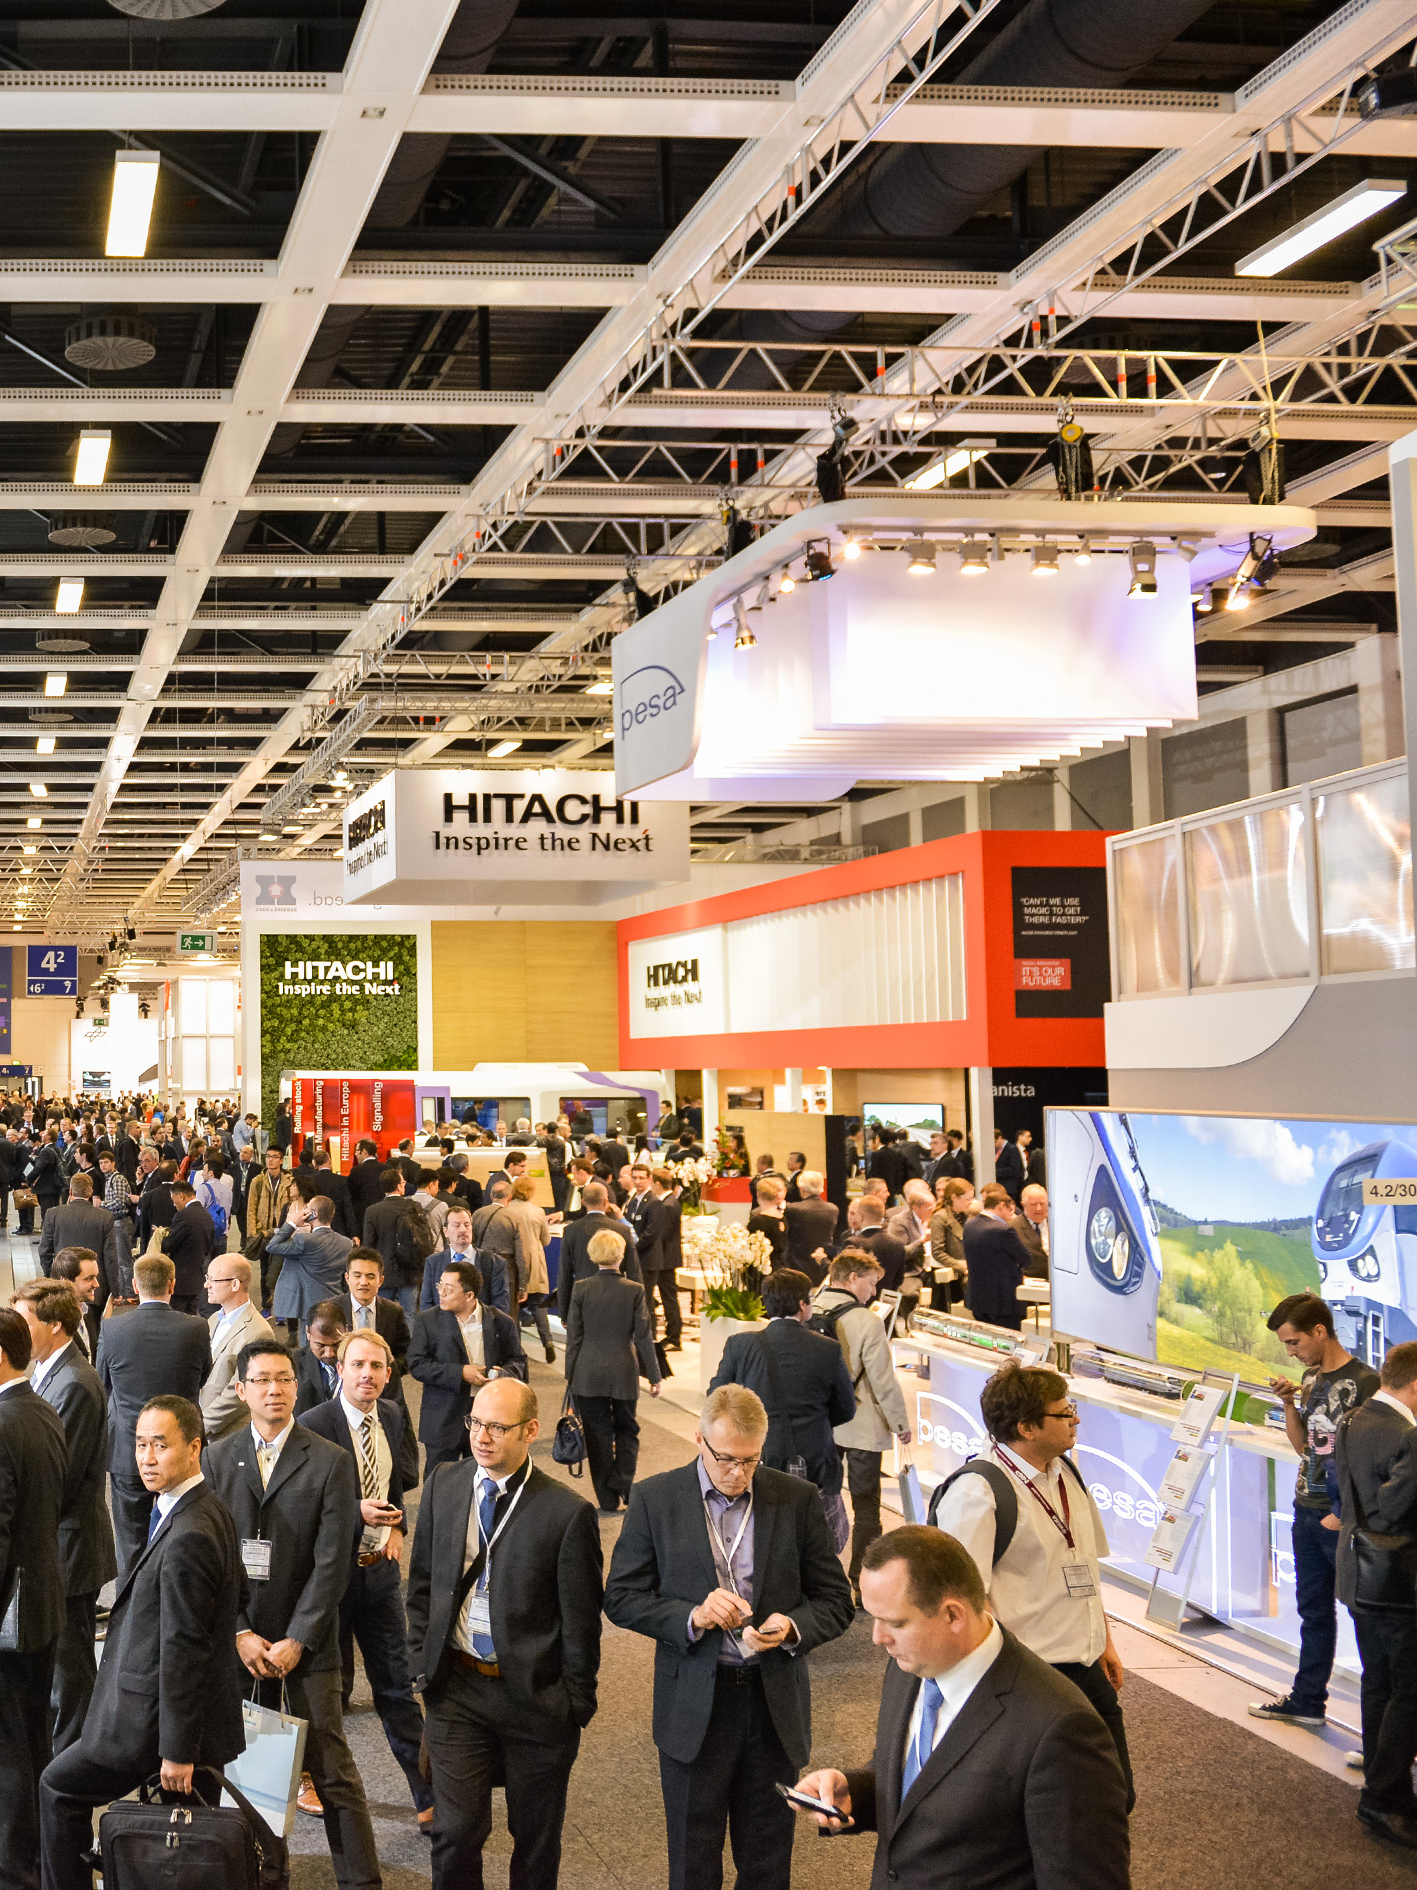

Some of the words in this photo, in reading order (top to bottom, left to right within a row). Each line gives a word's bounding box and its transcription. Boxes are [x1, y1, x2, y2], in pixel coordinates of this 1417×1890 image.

[621, 685, 677, 741] pesa
[443, 792, 640, 825] HITACHI
[432, 830, 528, 855] Inspire
[538, 831, 581, 851] the
[589, 828, 654, 852] Next
[1024, 906, 1050, 915] MAGIC
[1052, 906, 1063, 915] TO
[1065, 906, 1081, 915] GET
[1049, 897, 1062, 906] WE
[1064, 897, 1080, 906] USE
[1024, 915, 1050, 924] THERE
[285, 961, 394, 980] HITACHI
[646, 958, 699, 988] HITACHI
[1022, 967, 1040, 976] IT'S
[1042, 967, 1064, 976] OUR
[278, 982, 331, 997] Inspire
[336, 982, 360, 995] the
[364, 981, 400, 995] Next
[1023, 976, 1061, 986] FUTURE
[294, 1080, 302, 1100] stock
[341, 1081, 351, 1115] Europe
[992, 1082, 1036, 1097] anista
[315, 1080, 324, 1144] Manufacturing
[373, 1081, 383, 1132] Signalling
[294, 1103, 303, 1134] Rolling
[341, 1118, 350, 1127] in
[341, 1129, 350, 1161] Hitachi
[1370, 1184, 1416, 1197] 4.2/30
[1088, 1482, 1163, 1530] esa
